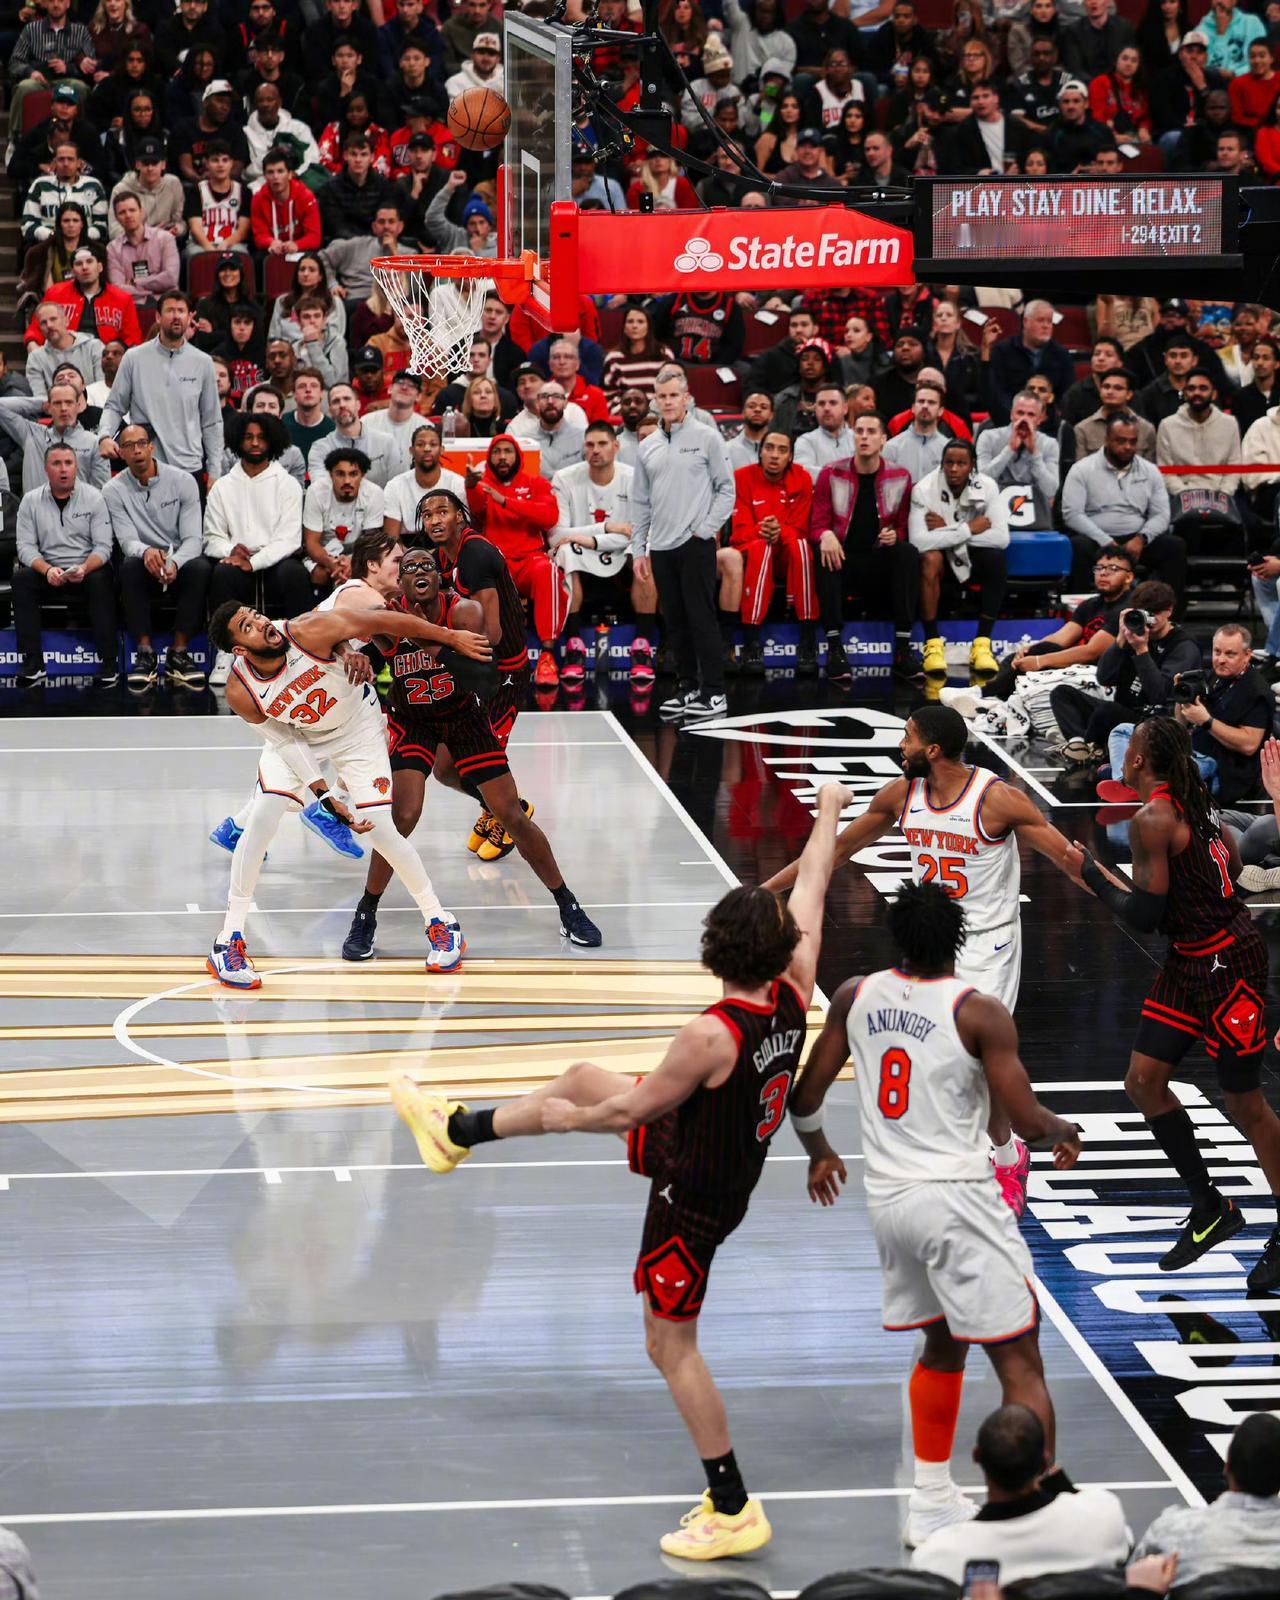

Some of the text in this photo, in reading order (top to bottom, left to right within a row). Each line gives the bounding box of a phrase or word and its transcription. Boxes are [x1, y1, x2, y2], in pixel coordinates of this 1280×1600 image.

[952, 187, 1203, 217] PLAY. STAY. DINE. RELAX.
[1159, 225, 1191, 244] EXIT
[1192, 225, 1201, 243] 2
[1180, 489, 1229, 514] BULLS
[266, 664, 326, 719] NEW YORK
[290, 687, 338, 725] 32
[406, 672, 454, 705] 25
[904, 828, 979, 855] NEW YORK
[917, 853, 969, 900] 25
[867, 1008, 936, 1042] ANUNOBY
[752, 1029, 801, 1074] GIDDEY
[877, 1046, 912, 1120] 8
[756, 1070, 793, 1143] 3
